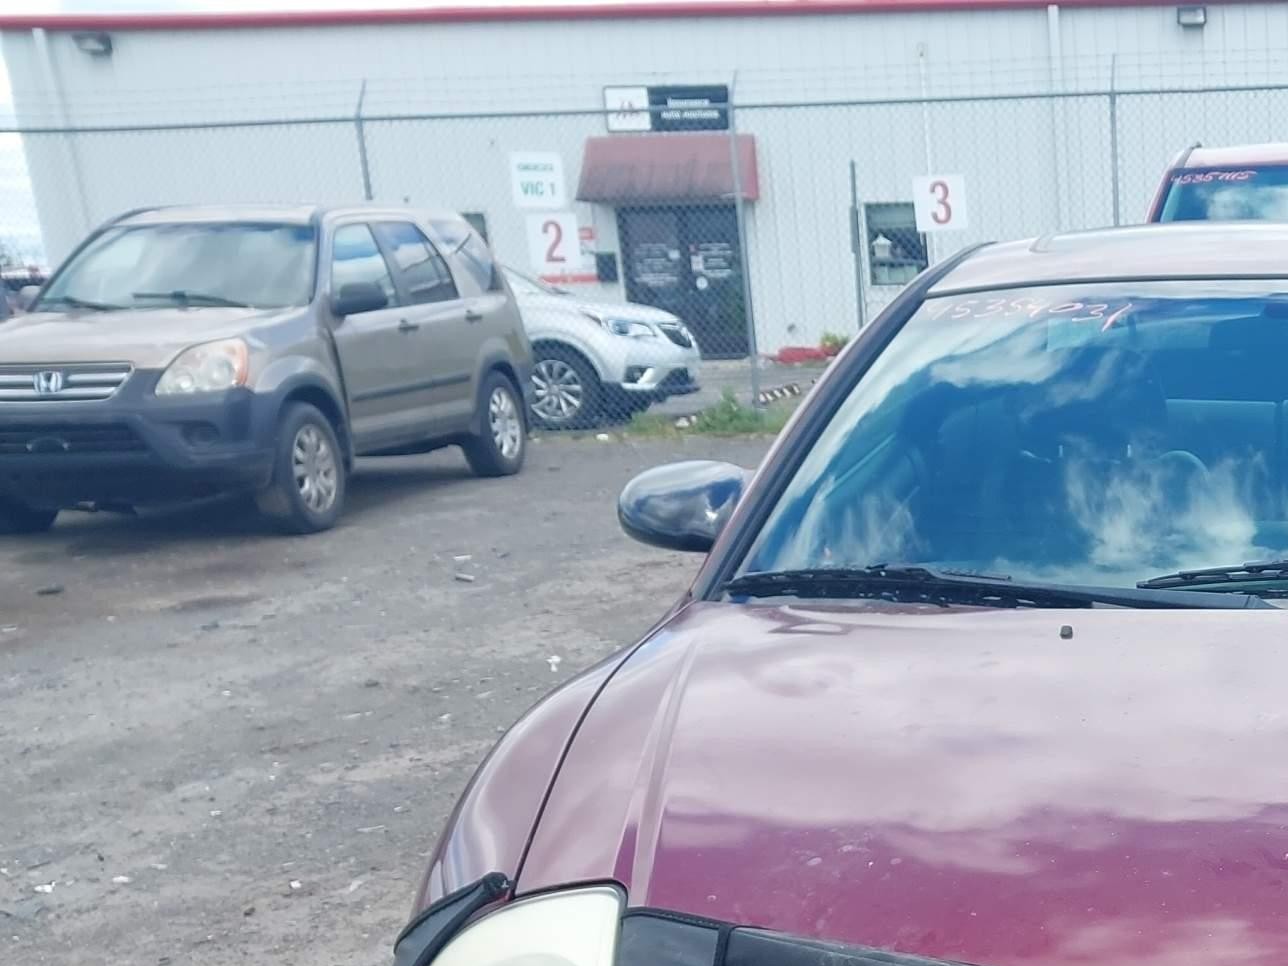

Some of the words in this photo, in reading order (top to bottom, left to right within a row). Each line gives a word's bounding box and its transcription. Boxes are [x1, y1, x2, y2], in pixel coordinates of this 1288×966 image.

[930, 180, 952, 225] 3
[542, 220, 566, 262] 2
[926, 298, 1133, 332] 45354031
